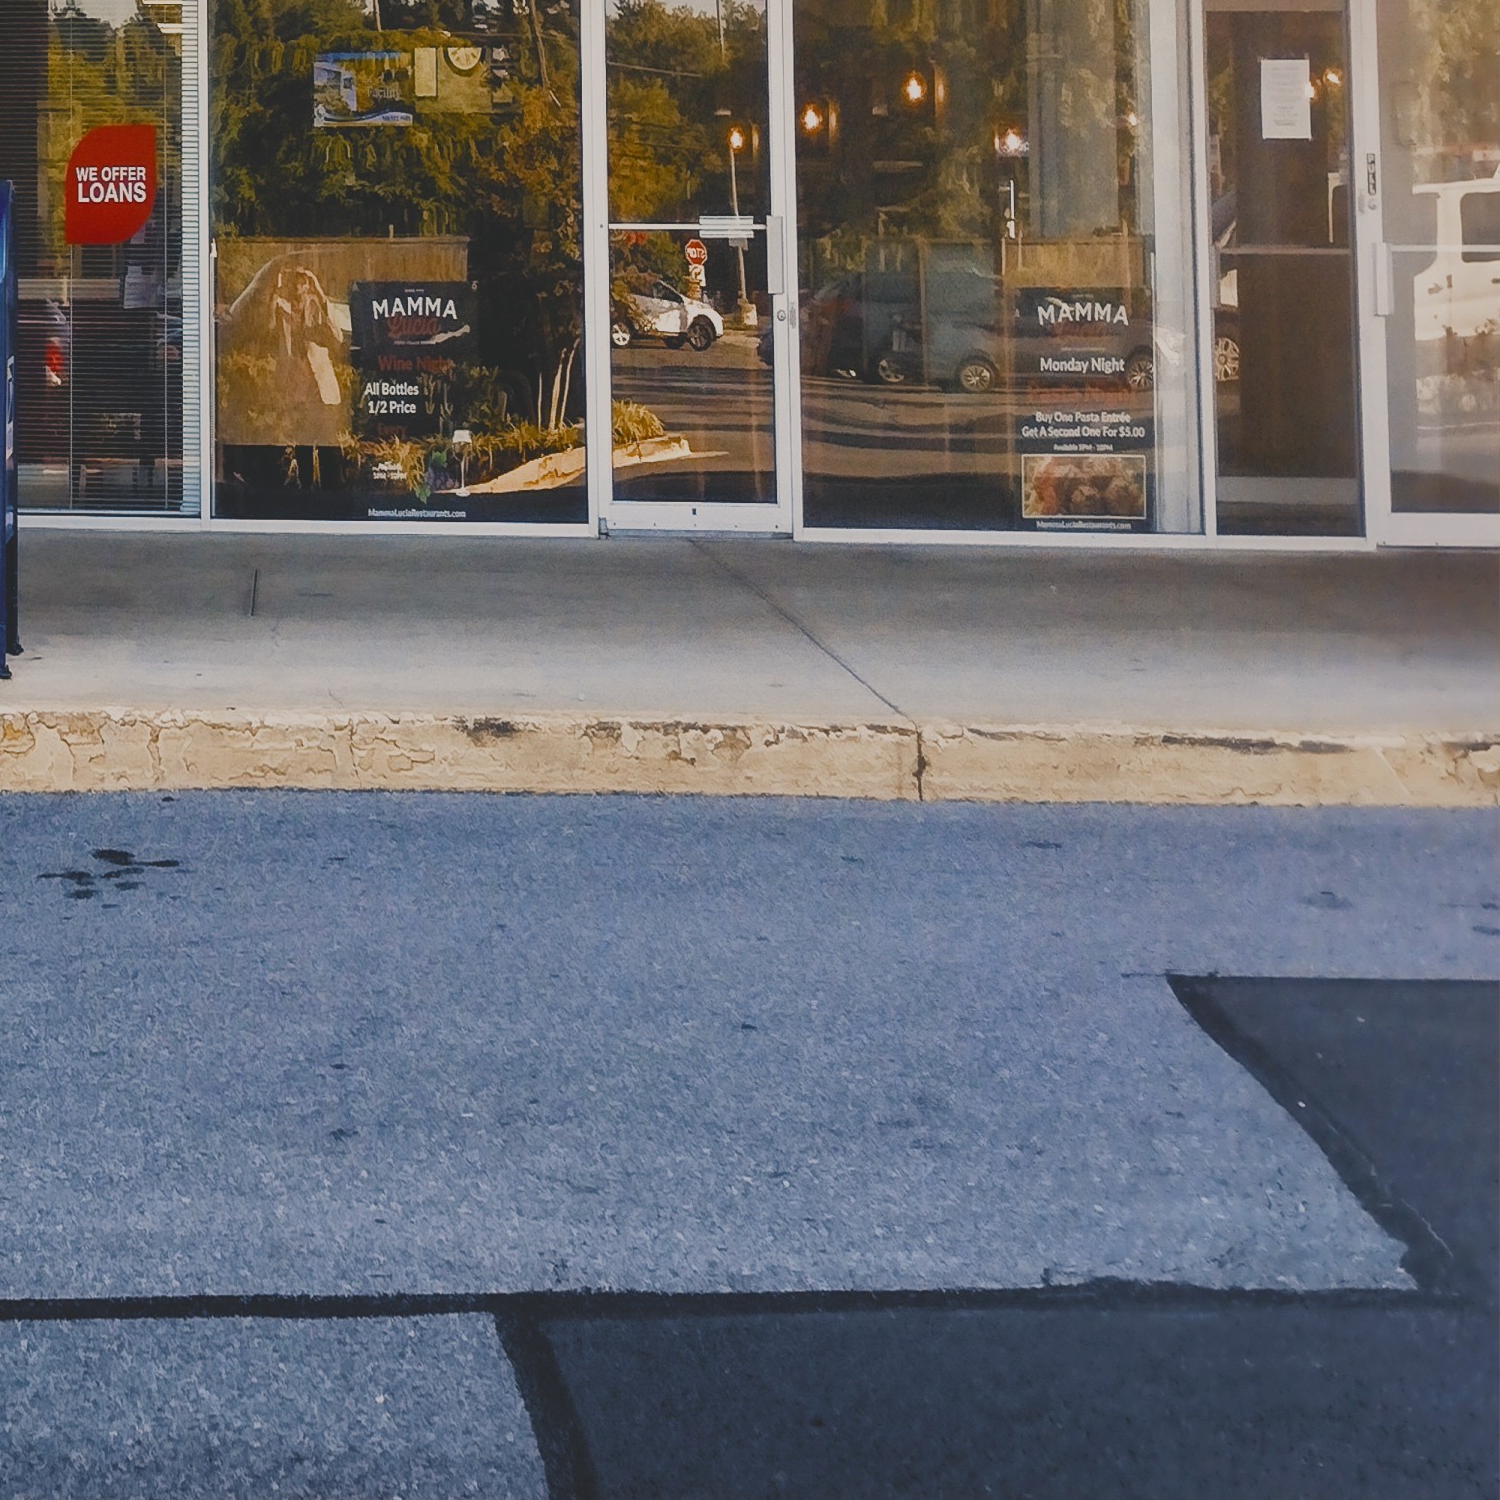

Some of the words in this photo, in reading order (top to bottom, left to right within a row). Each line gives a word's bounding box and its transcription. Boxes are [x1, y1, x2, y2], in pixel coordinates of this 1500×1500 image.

[76, 167, 98, 181] WE
[102, 167, 146, 181] OFFER
[78, 183, 146, 203] LOANS
[372, 296, 457, 320] MAMMA
[1037, 302, 1129, 326] MAMMA
[378, 356, 412, 371] Wine
[1040, 358, 1088, 374] Monday
[1091, 358, 1125, 374] Night
[365, 382, 379, 395] All
[382, 382, 419, 396] Bottles
[368, 401, 387, 414] 1/2
[390, 401, 416, 414] Price
[1035, 412, 1052, 423] Buy
[1055, 412, 1073, 422] One
[1075, 412, 1099, 422] Pasta
[1022, 426, 1039, 438] Get
[1040, 427, 1047, 437] A
[1048, 427, 1080, 438] Second
[1082, 427, 1100, 438] One
[1103, 427, 1117, 437] For
